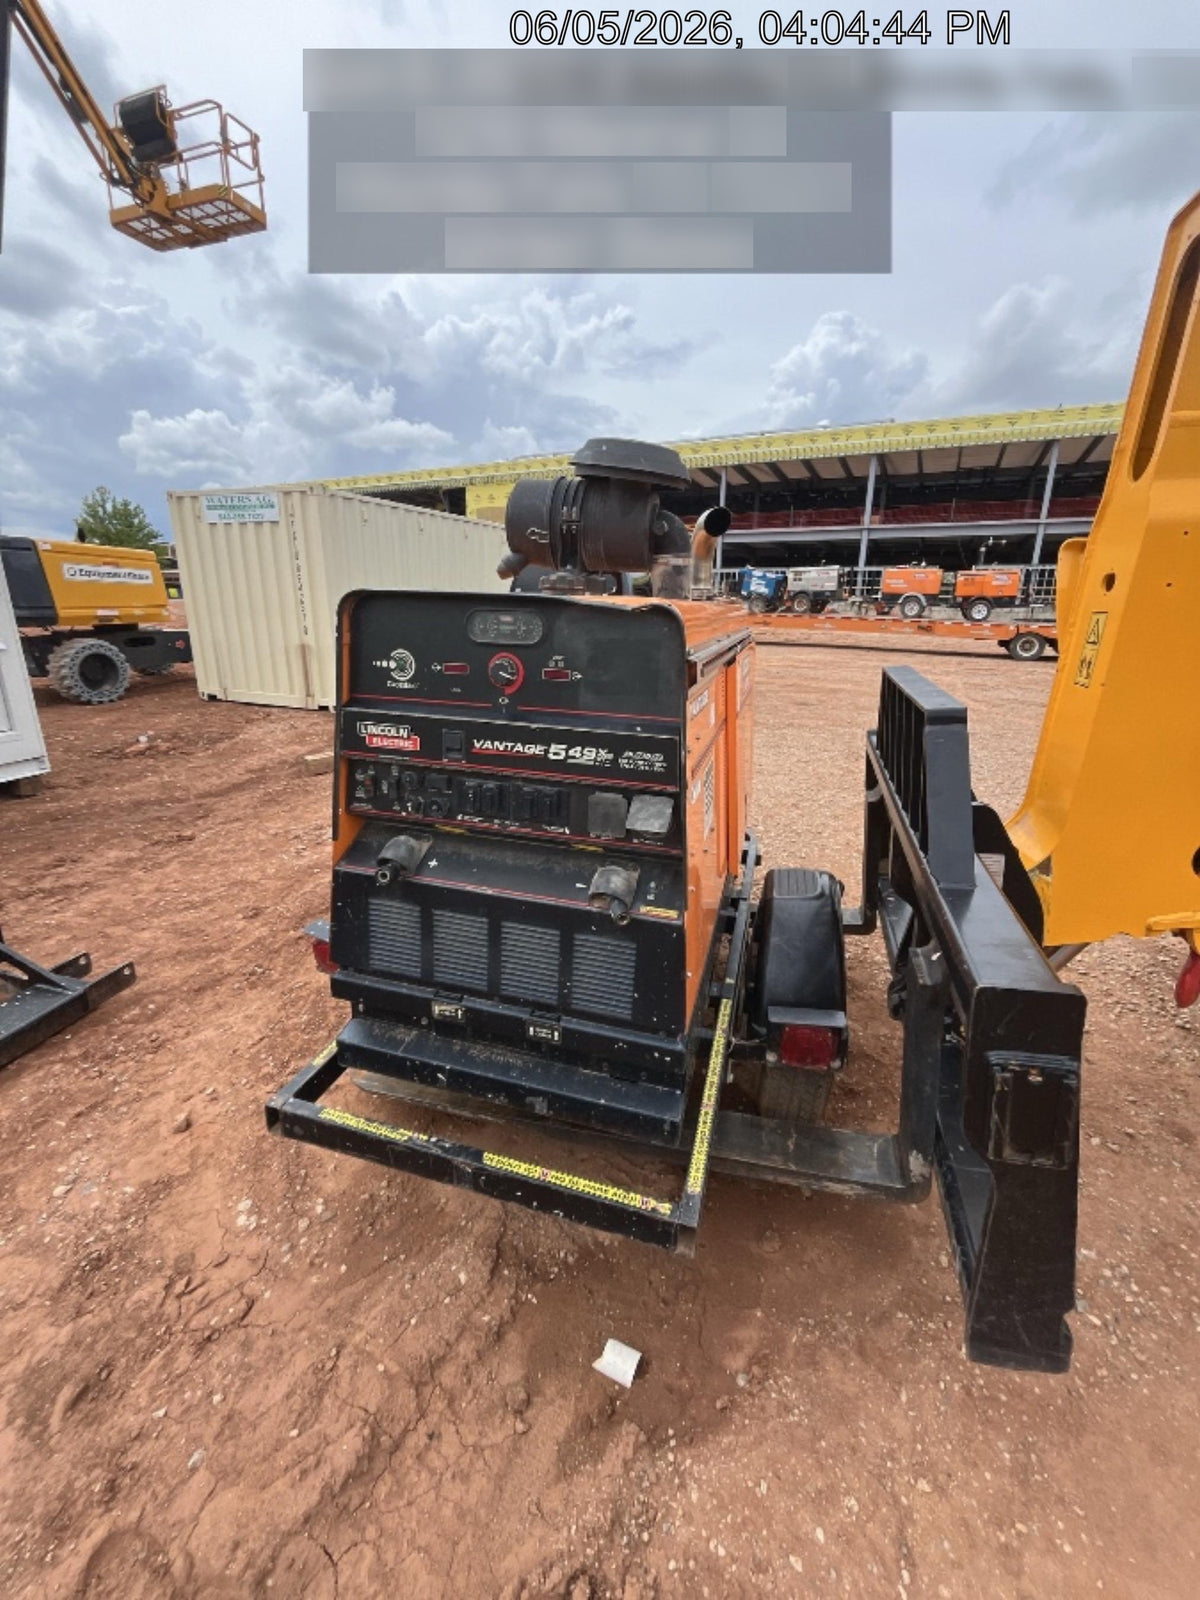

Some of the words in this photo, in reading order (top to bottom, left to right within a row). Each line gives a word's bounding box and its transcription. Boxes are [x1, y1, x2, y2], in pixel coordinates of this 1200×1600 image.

[360, 724, 408, 738] LINCOLN
[372, 736, 414, 749] ELECTRIC
[473, 739, 547, 754] VANTAGE
